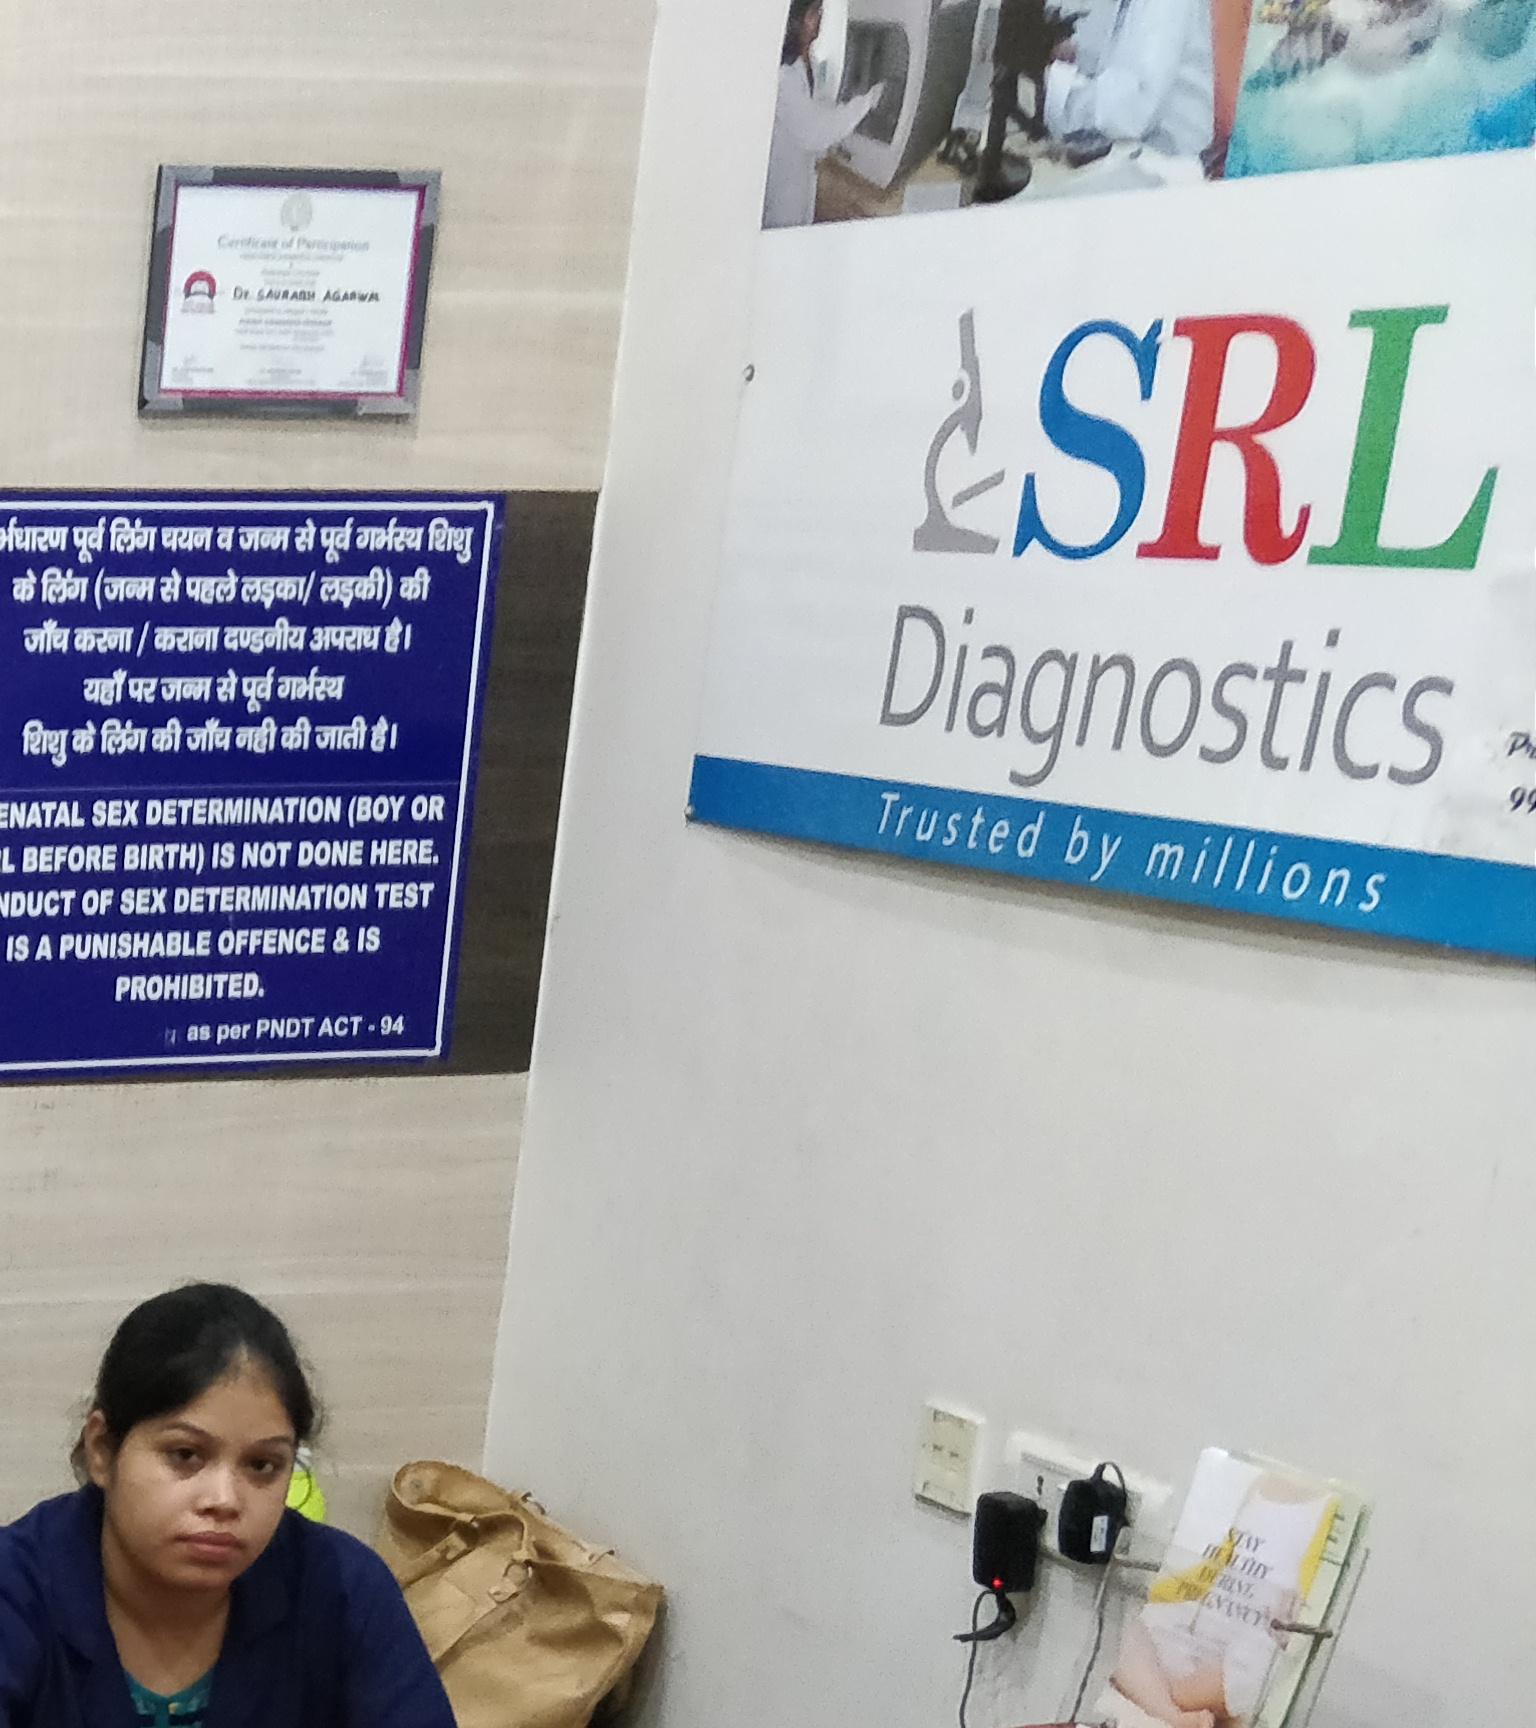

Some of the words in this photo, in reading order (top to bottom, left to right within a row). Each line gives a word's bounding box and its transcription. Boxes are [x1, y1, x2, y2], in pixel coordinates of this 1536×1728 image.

[282, 237, 293, 249] of
[297, 238, 369, 251] Participation
[1012, 303, 1498, 570] SRL
[73, 516, 106, 563] पूर्व
[110, 517, 157, 553] लिंग
[217, 526, 235, 552] व
[239, 526, 290, 551] जन्म
[295, 518, 316, 551] से
[321, 517, 354, 563] पूर्व
[428, 517, 474, 563] शिशु
[13, 568, 36, 603] के
[41, 567, 88, 603] लिंग
[160, 567, 181, 603] से
[186, 567, 238, 604] पहले
[400, 566, 431, 601] की
[74, 627, 134, 653] करना
[154, 626, 220, 652] कराना
[310, 626, 381, 651] अपराध
[129, 678, 158, 703] पर
[161, 677, 212, 703] जन्म
[217, 668, 238, 702] से
[243, 666, 275, 713] पूर्व
[879, 604, 1455, 787] Diagnostics
[23, 719, 68, 767] शिशु
[72, 720, 96, 754] के
[101, 718, 148, 755] लिंग
[152, 717, 182, 752] की
[281, 716, 312, 750] की
[315, 715, 367, 750] जाती
[92, 800, 139, 827] SEX
[145, 796, 341, 827] DETERMINATION
[348, 795, 405, 828] (BOY
[411, 795, 445, 822] OR
[22, 845, 117, 873] BEFORE
[124, 843, 204, 875] BIRTH)
[212, 842, 234, 869] IS
[241, 842, 292, 869] NOT
[297, 840, 363, 867] DONE
[370, 839, 439, 865] HERE.
[878, 792, 1039, 859] Trusted
[1064, 824, 1121, 881] by
[1145, 840, 1387, 912] millions
[82, 888, 114, 916] OF
[120, 887, 167, 916] SEX
[173, 884, 368, 914] DETERMINATION
[375, 882, 434, 909] TEST
[6, 935, 29, 962] IS
[35, 935, 53, 961] A
[59, 931, 211, 960] PUNISHABLE
[218, 929, 326, 954] OFFENCE
[332, 927, 350, 952] &
[357, 926, 381, 952] IS
[115, 972, 265, 1001] PROHIBITED.
[187, 1024, 210, 1041] as
[216, 1024, 251, 1044] per
[256, 1018, 314, 1039] PNDT
[318, 1017, 361, 1037] ACT
[381, 1016, 405, 1035] 94
